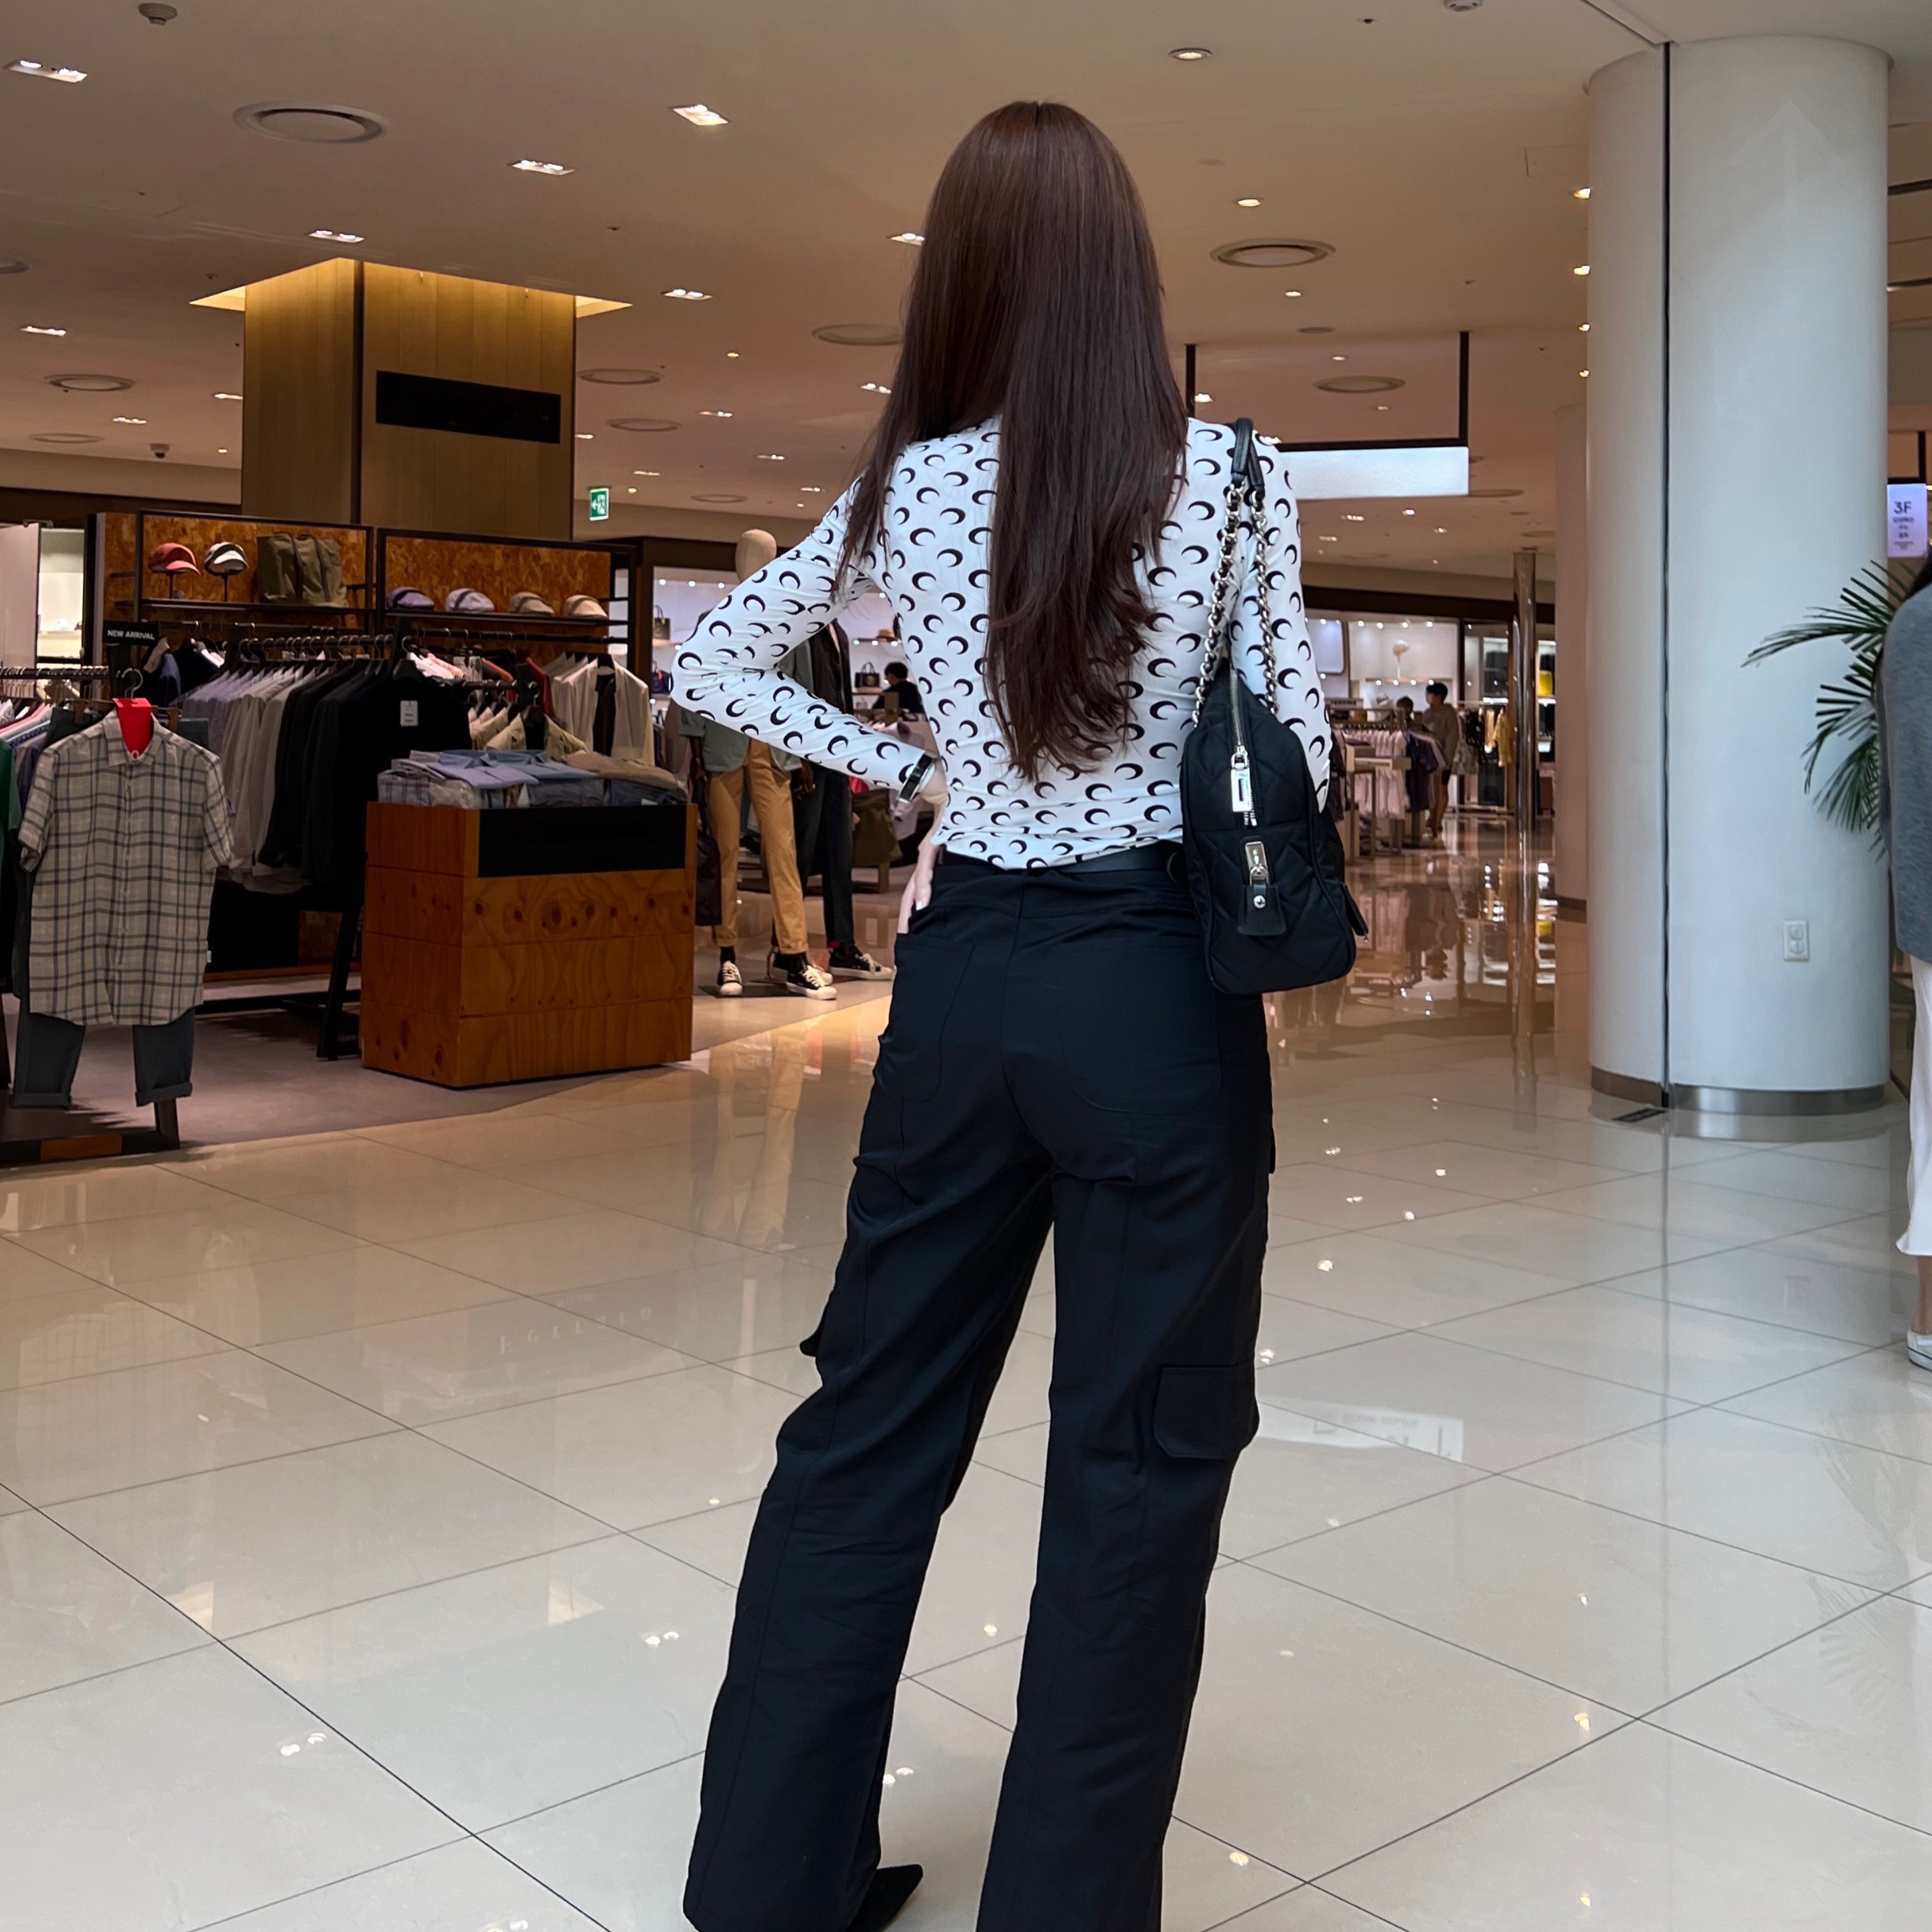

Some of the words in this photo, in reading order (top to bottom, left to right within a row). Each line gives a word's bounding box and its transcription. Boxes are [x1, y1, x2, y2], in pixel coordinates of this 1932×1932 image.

[1894, 501, 1912, 514] 3F
[107, 629, 124, 638] NEW
[125, 631, 155, 640] ARRIVAL
